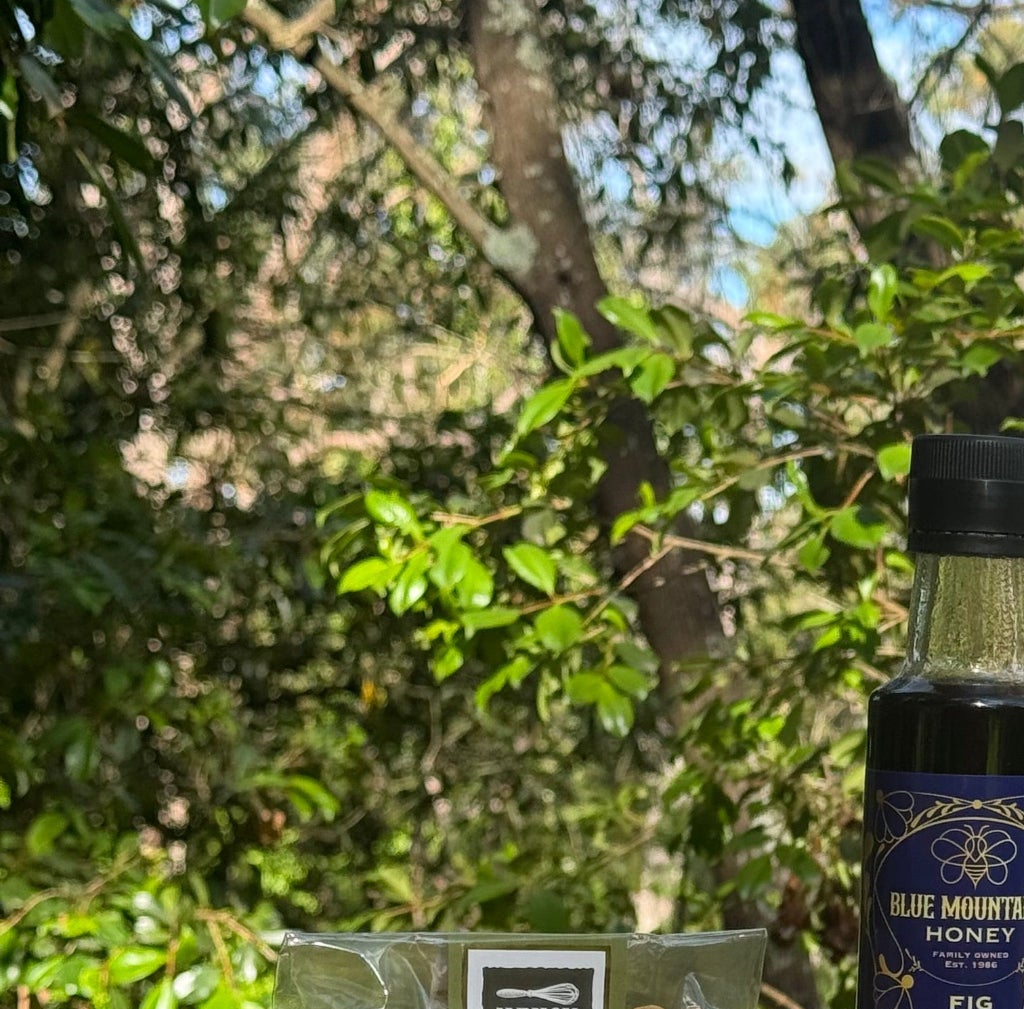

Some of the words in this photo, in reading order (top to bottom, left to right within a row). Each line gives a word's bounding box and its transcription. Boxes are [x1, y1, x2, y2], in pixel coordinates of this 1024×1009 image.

[890, 892, 935, 918] BLUE
[926, 926, 1016, 943] HONEY
[932, 951, 971, 960] FAMILY
[974, 952, 1009, 960] OWNED
